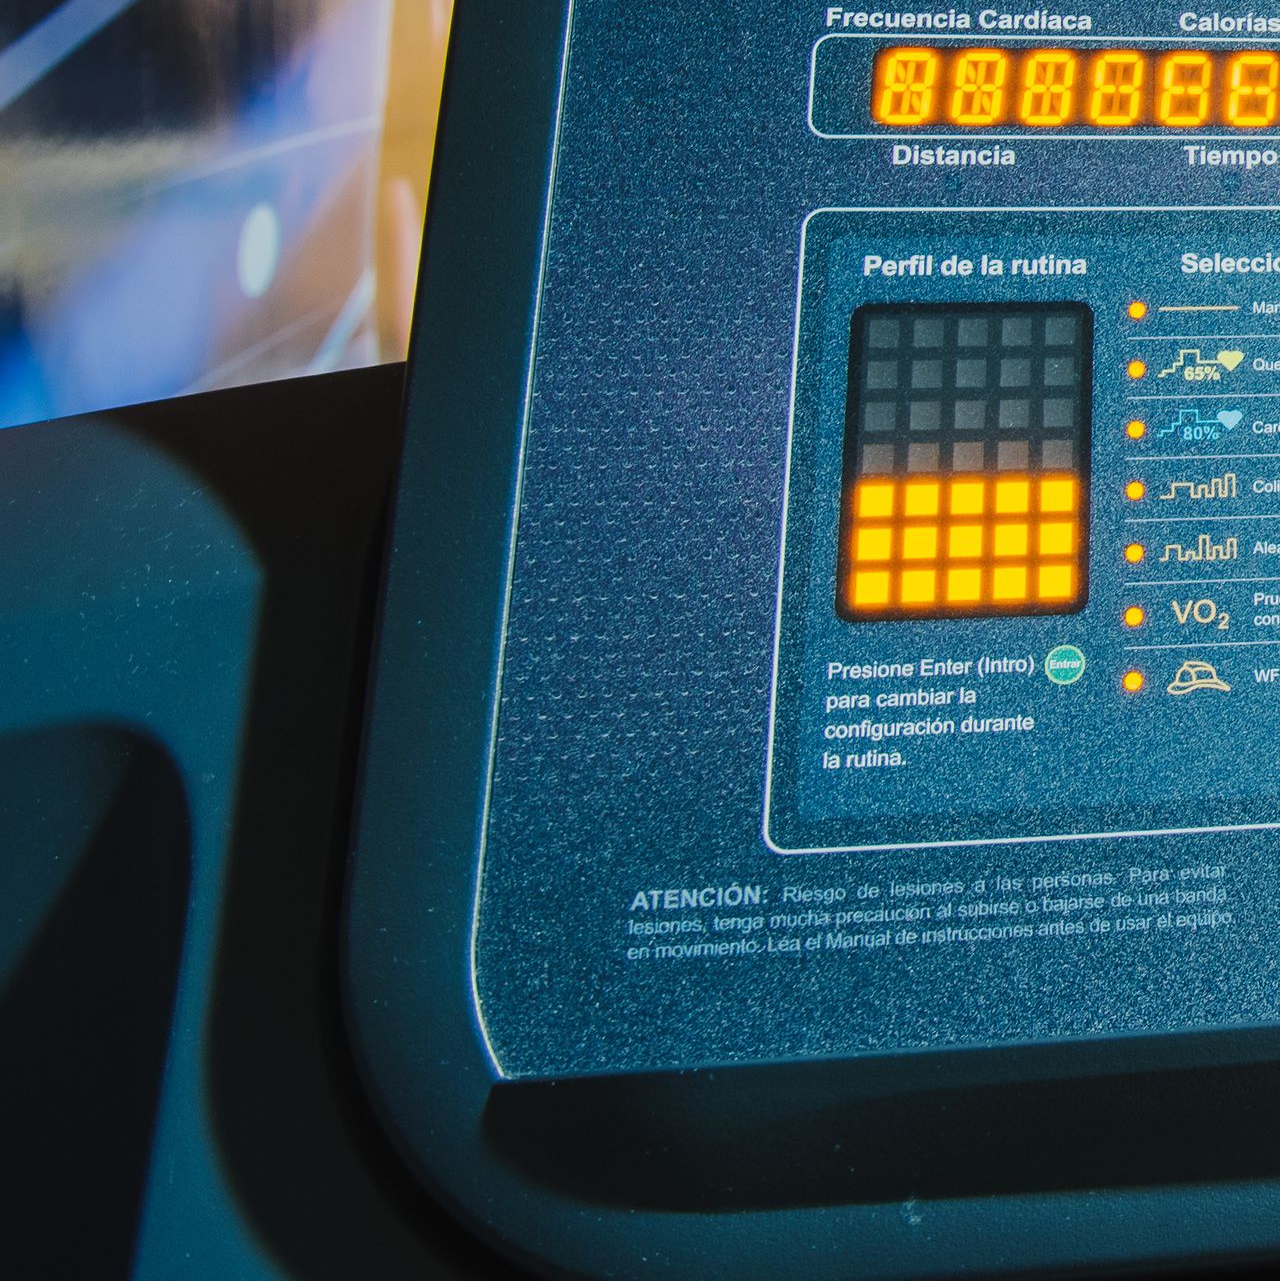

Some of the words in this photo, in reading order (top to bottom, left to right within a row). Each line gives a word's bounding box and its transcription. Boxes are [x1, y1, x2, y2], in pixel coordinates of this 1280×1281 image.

[826, 7, 970, 30] Frecuencia
[978, 9, 1092, 30] Cardíaca
[892, 144, 1016, 166] Distancia
[1183, 145, 1278, 169] Tiempo
[863, 255, 933, 276] Perfil
[939, 255, 974, 275] de
[980, 255, 1004, 275] la
[1010, 254, 1087, 275] rutina
[1183, 365, 1220, 382] 65%
[1183, 425, 1220, 441] 80%
[827, 662, 914, 680] Presione
[919, 659, 971, 677] Enter
[976, 655, 1035, 676] (Intro)
[1049, 658, 1082, 671] Entrar
[825, 694, 869, 711] para
[875, 689, 953, 707] cambiar
[958, 688, 976, 704] la
[824, 718, 955, 740] configuración
[962, 713, 1034, 732] durante
[823, 751, 841, 769] la
[846, 748, 907, 767] rutina.
[630, 884, 769, 911] ATENCIÓN:
[782, 883, 847, 905] Riesgo
[857, 881, 881, 899] de
[890, 876, 966, 897] lesiones
[974, 879, 986, 891] a
[997, 874, 1022, 892] las
[1128, 866, 1170, 883] Para
[1179, 863, 1228, 881] evitar
[712, 912, 765, 935] tenga
[769, 907, 830, 929] mucha
[834, 902, 933, 927] precaución
[937, 901, 954, 918] al
[957, 896, 1021, 918] subirse
[1024, 899, 1036, 913] o
[1041, 892, 1104, 915] bajarse
[1109, 890, 1133, 907] de
[1137, 891, 1170, 906] una
[1173, 884, 1228, 904] banda
[627, 944, 651, 961] en
[806, 929, 823, 948] el
[825, 924, 890, 948] Manual
[895, 926, 918, 944] de
[921, 918, 1034, 943] instrucciones
[1038, 920, 1087, 936] antes
[1090, 917, 1112, 933] de
[1116, 918, 1151, 932] usar
[1156, 911, 1171, 929] el
